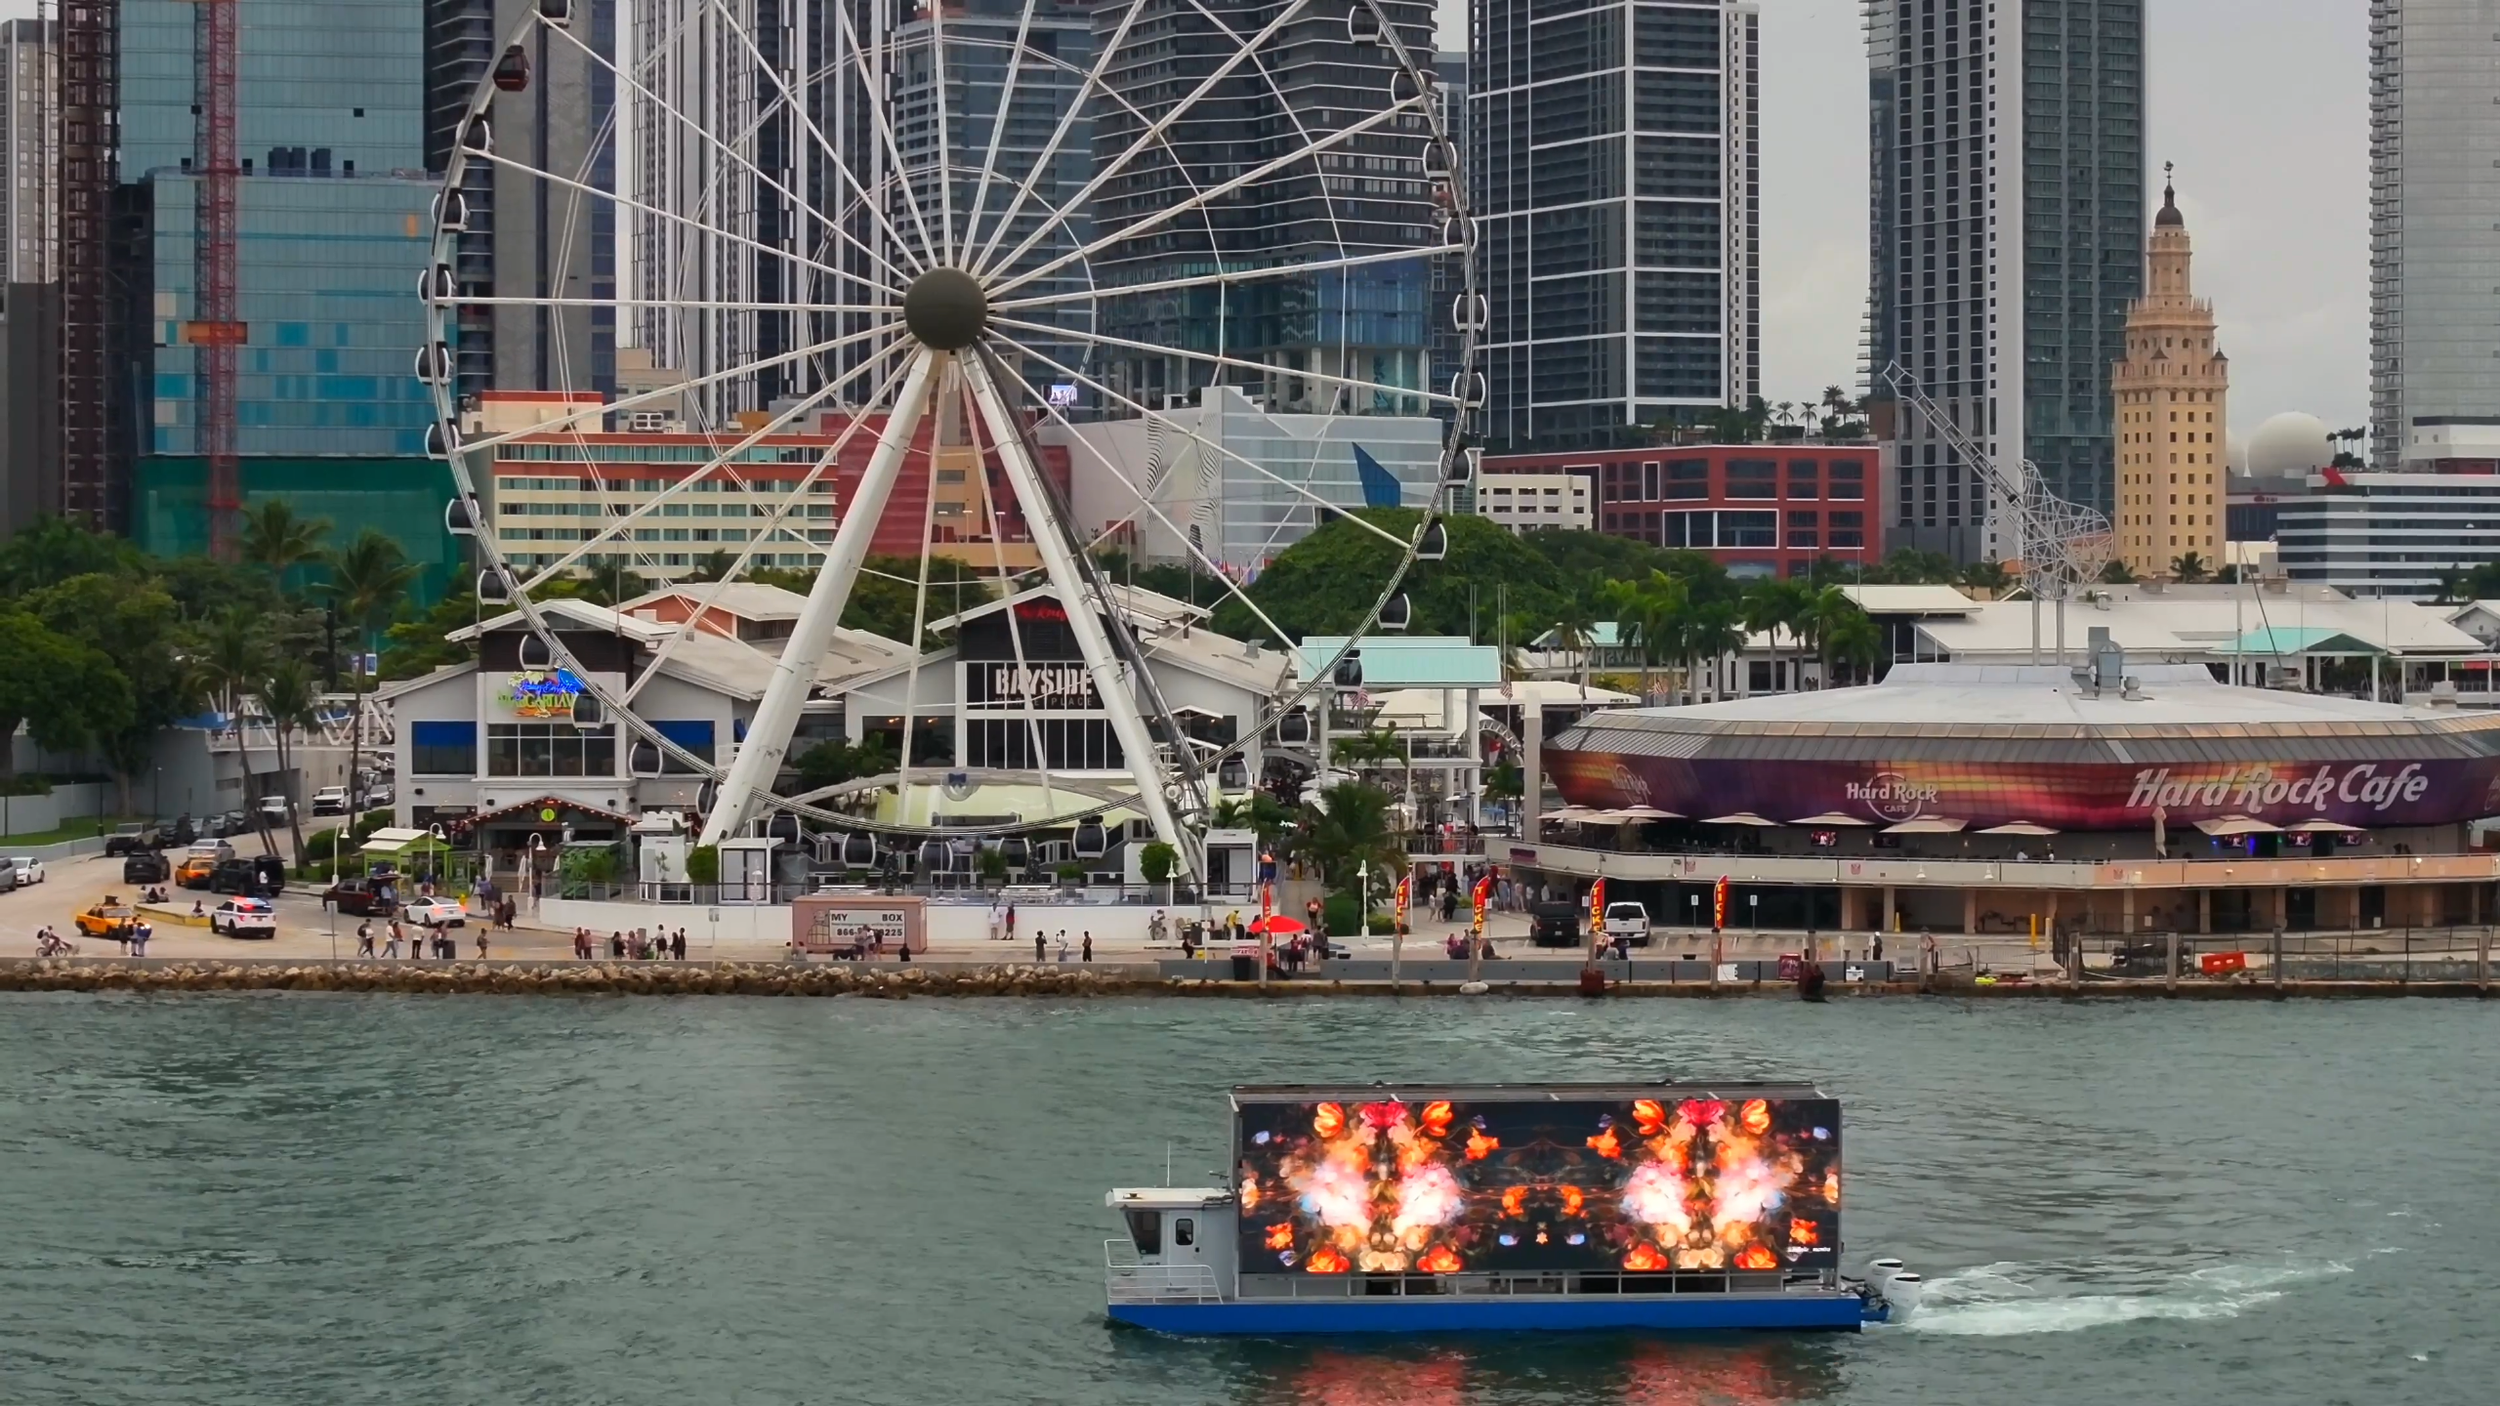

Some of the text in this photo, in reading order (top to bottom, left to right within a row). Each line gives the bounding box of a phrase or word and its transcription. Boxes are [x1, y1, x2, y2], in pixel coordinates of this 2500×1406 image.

[995, 668, 1092, 694] BAYSIDE
[995, 697, 1092, 706] MAREPLACE
[1845, 782, 1938, 804] Hard Rock
[2126, 763, 2428, 813] Hard Rock Cafe
[1884, 805, 1907, 813] CAFE
[831, 913, 903, 921] MY BOX
[1475, 886, 1483, 932] TICKE
[1591, 887, 1601, 932] TICKE
